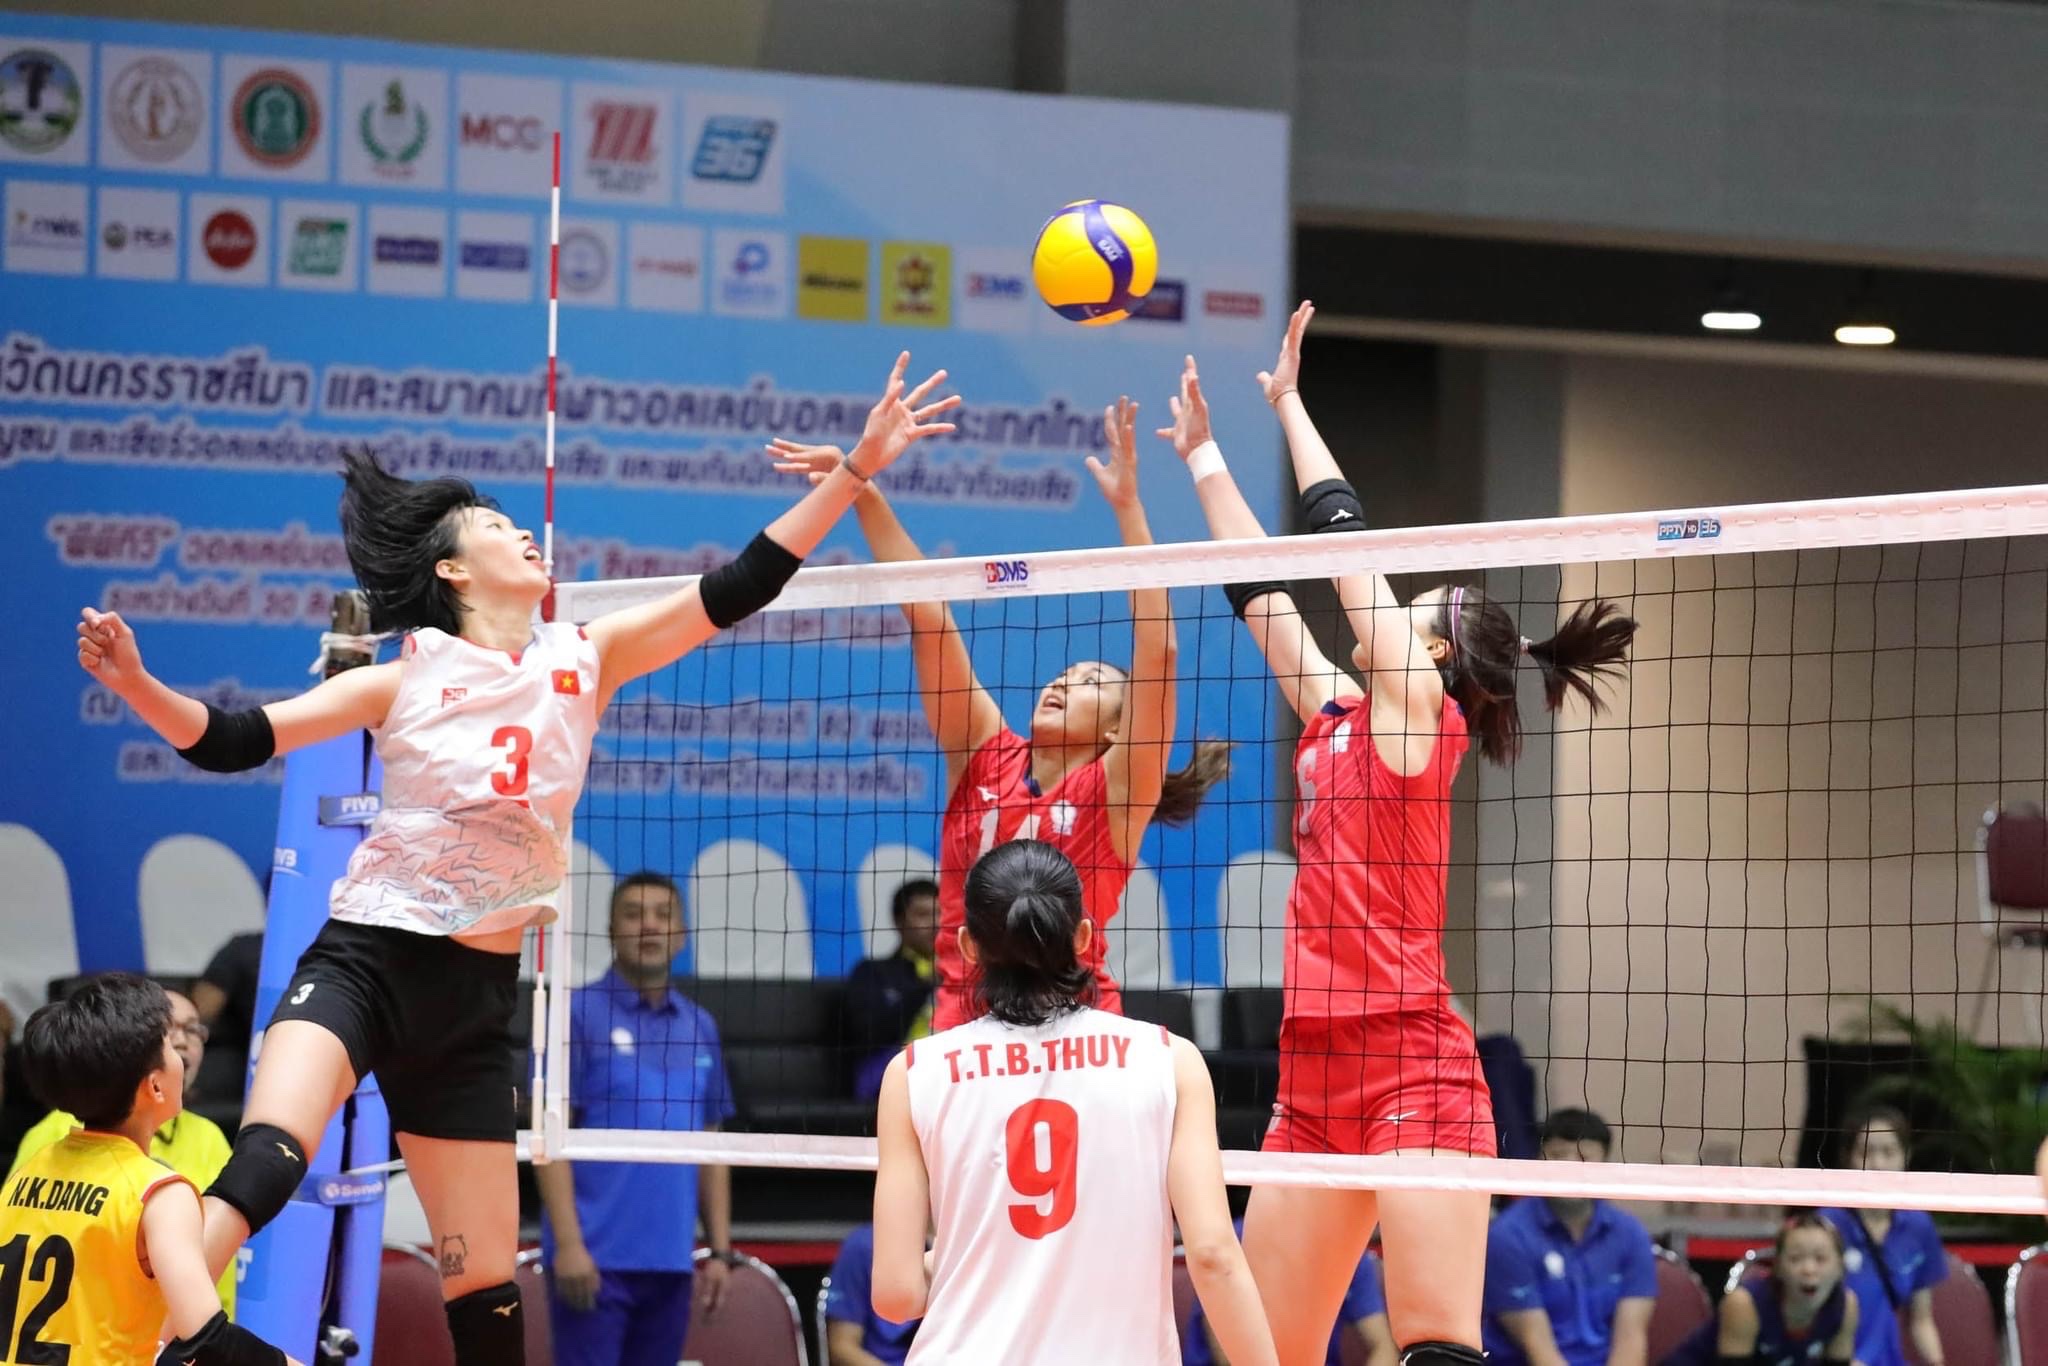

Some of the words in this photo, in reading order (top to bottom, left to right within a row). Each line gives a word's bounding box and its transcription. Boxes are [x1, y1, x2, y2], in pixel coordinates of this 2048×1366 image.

[0, 343, 309, 405] วัดนครราชสีมา
[1659, 521, 1686, 537] PPTV
[1702, 521, 1718, 534] 36
[985, 560, 1028, 583] BDMS
[491, 726, 533, 796] 3
[342, 796, 379, 812] FIVB
[290, 983, 315, 1005] 3
[944, 1035, 1131, 1083] T.T.B.THUY
[1005, 1098, 1078, 1240] 9
[8, 1177, 110, 1217] N.K.DANG
[0, 1234, 75, 1366] 12
